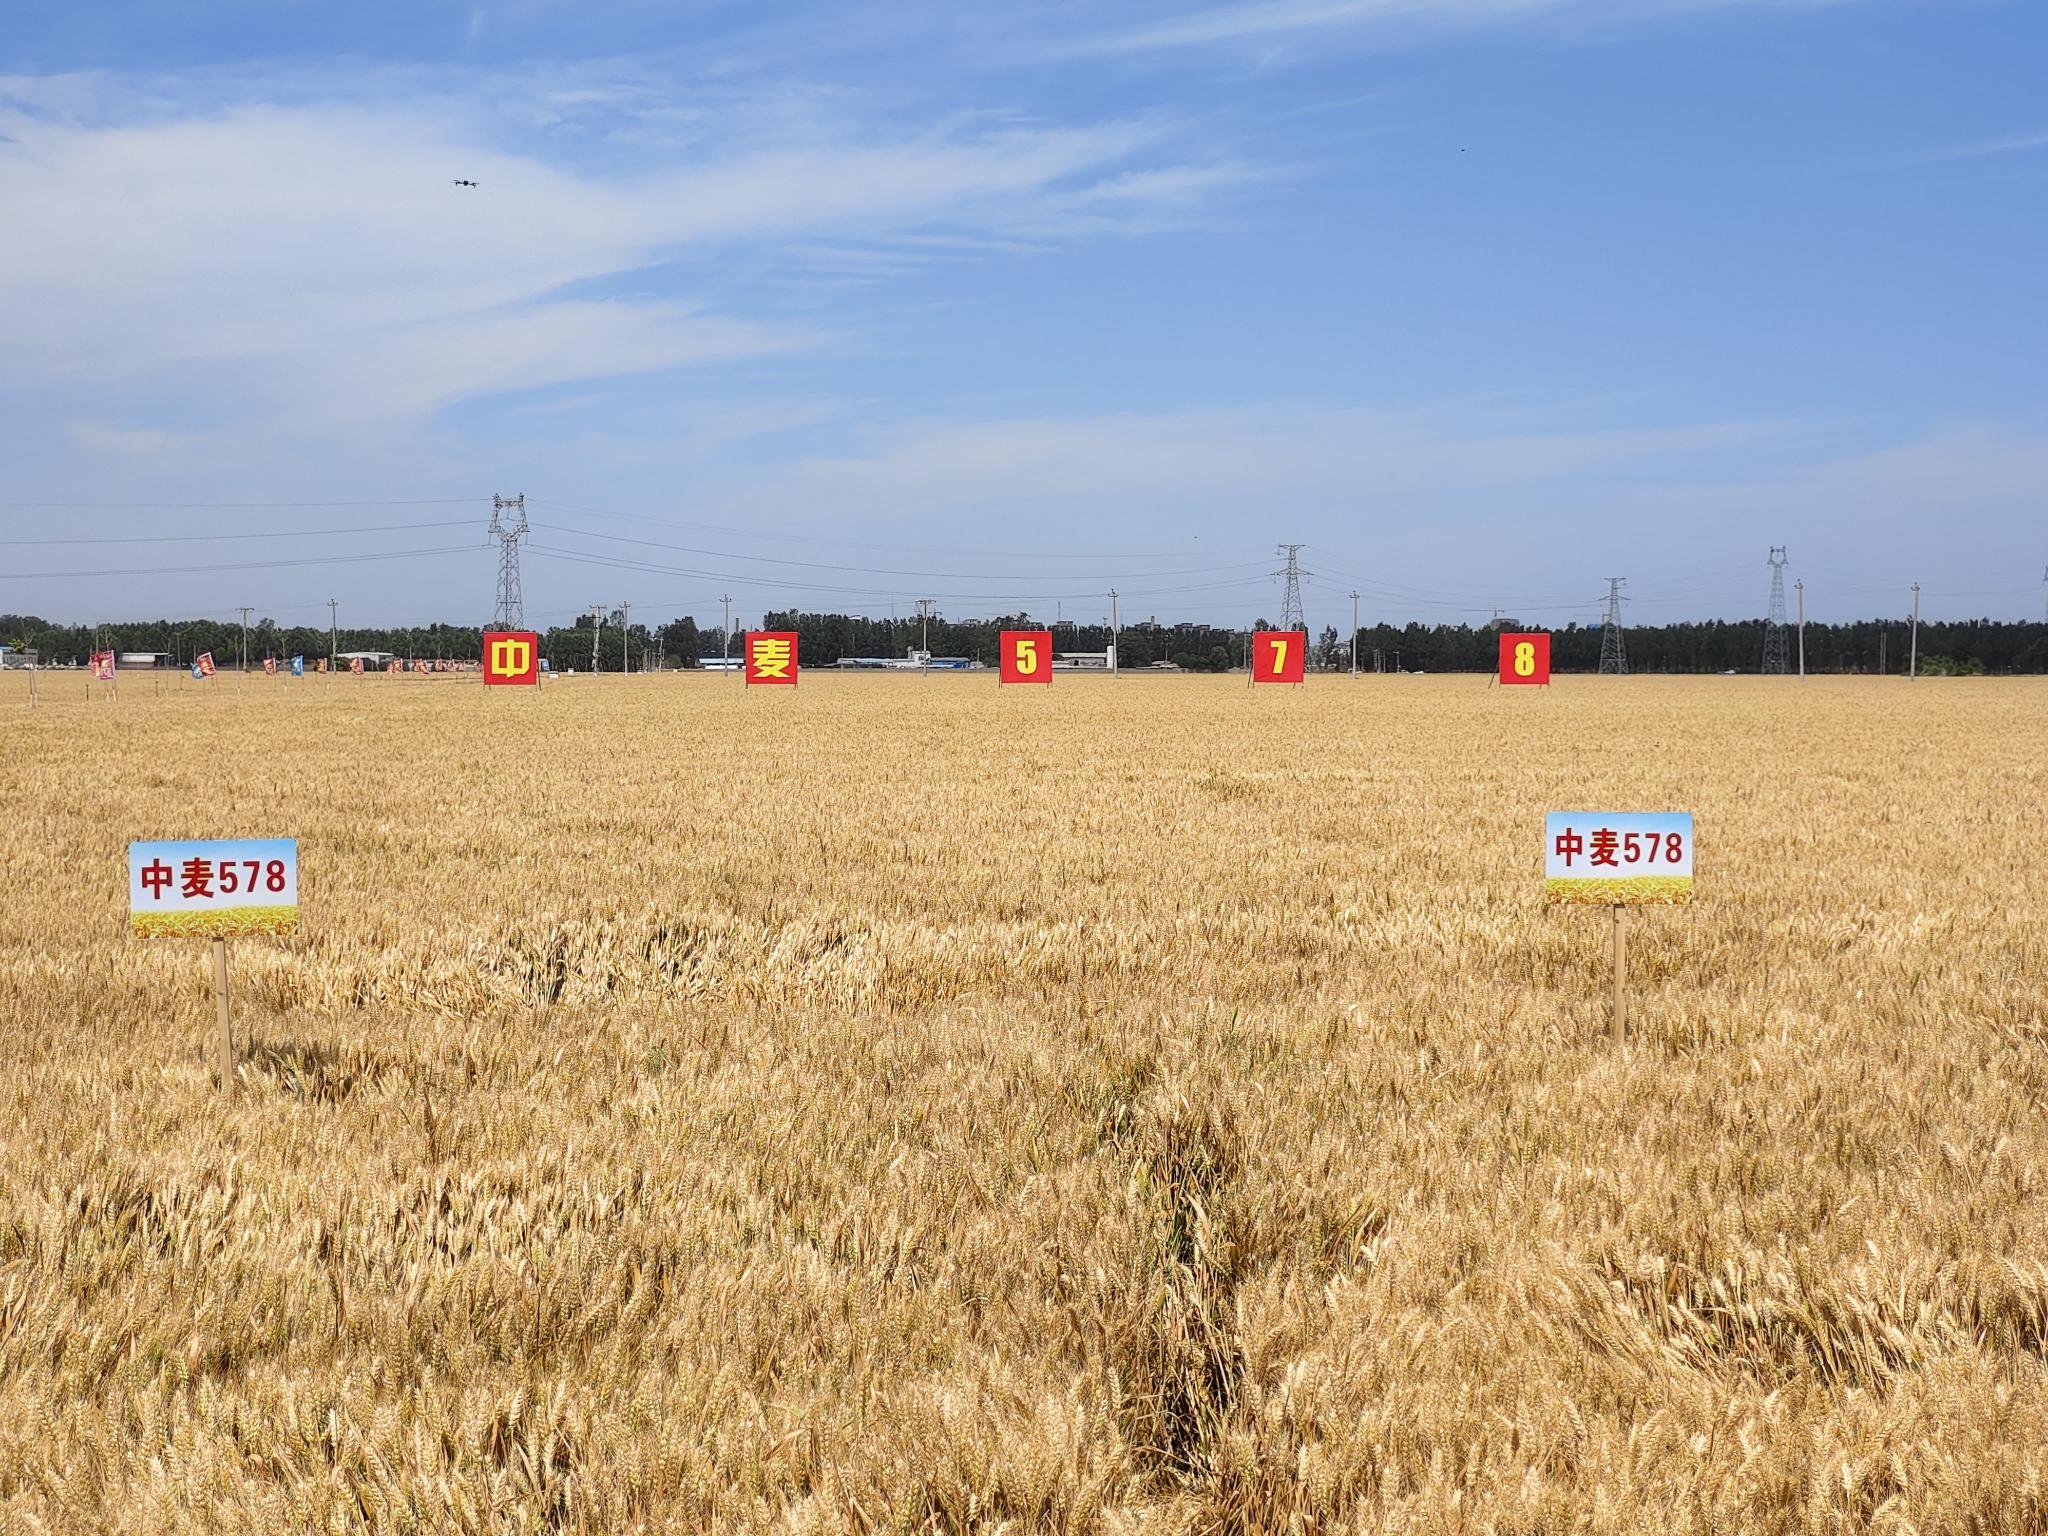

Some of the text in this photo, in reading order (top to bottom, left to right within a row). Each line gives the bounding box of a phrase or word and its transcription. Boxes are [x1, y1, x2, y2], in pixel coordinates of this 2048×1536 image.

[491, 639, 530, 677] 中
[752, 638, 791, 678] 麦
[1016, 640, 1037, 675] 5
[1270, 640, 1287, 674] 7
[1514, 642, 1535, 676] 8
[1556, 828, 1682, 867] 中麦578
[141, 857, 286, 899] 中麦578
